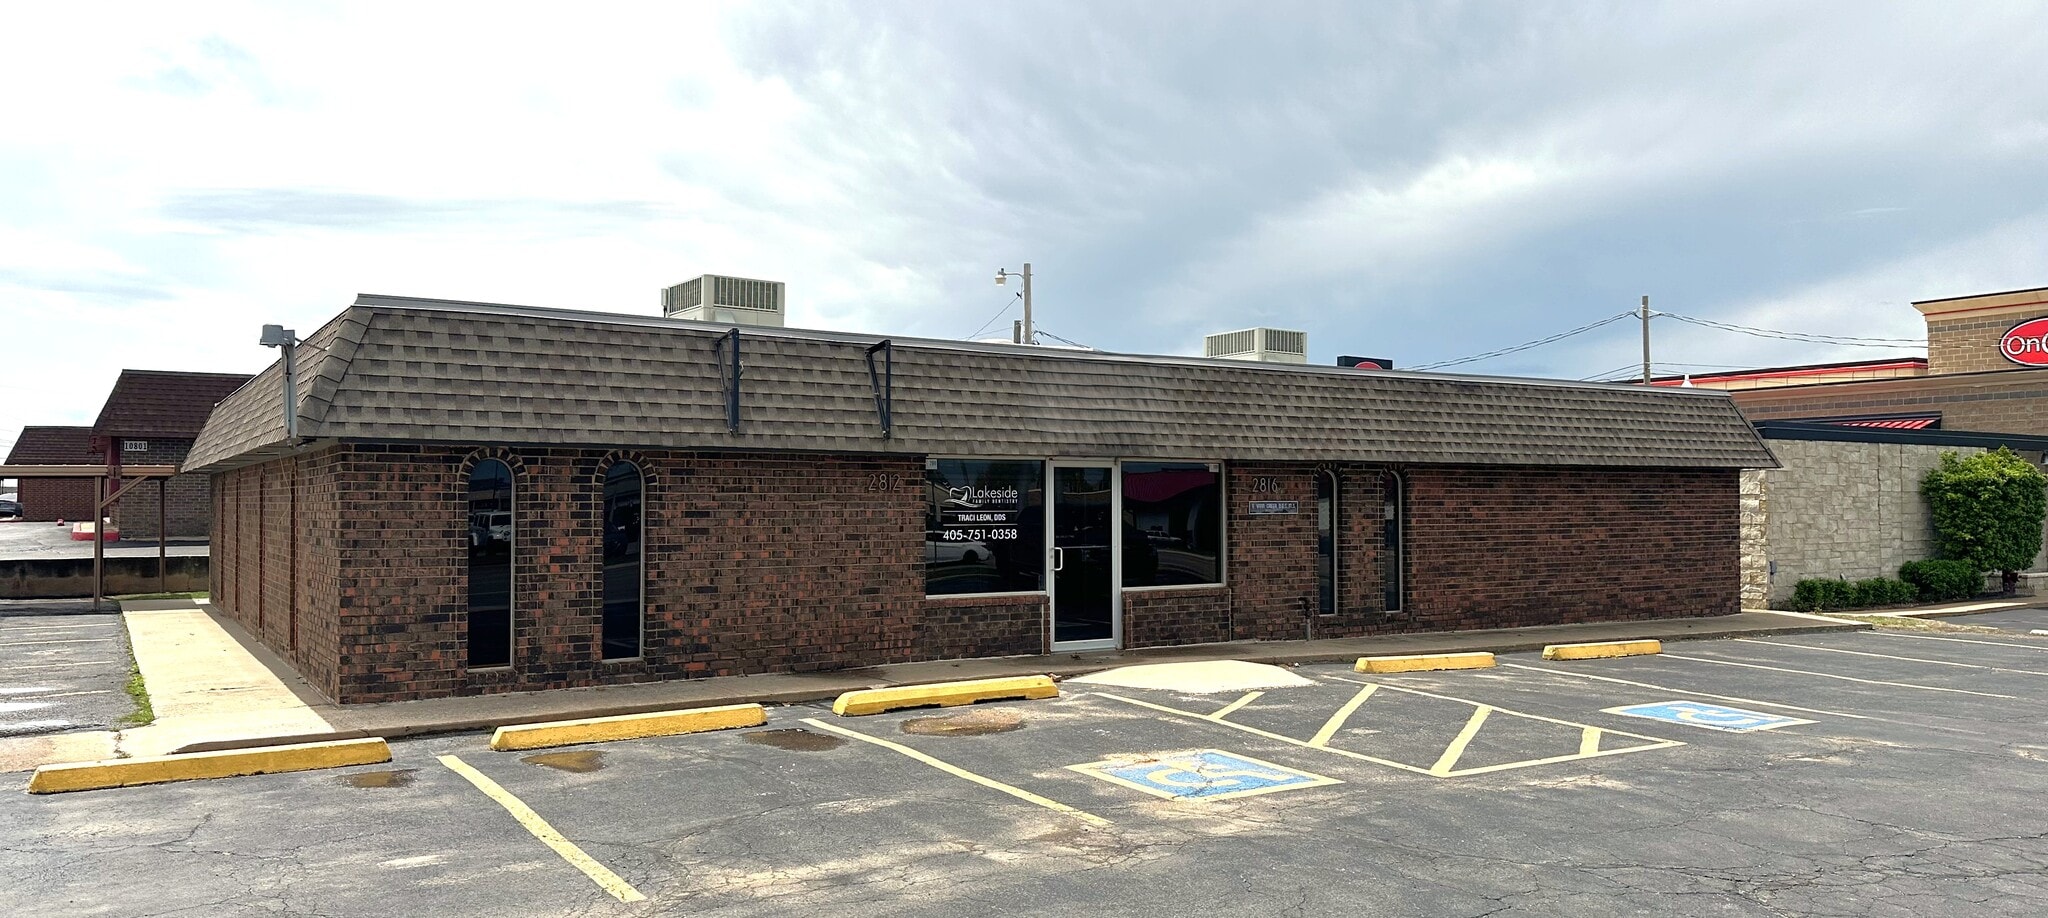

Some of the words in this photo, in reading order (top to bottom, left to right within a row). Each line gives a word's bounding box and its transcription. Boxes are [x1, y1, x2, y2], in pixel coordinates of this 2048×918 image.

[124, 442, 147, 450] 10801
[868, 473, 900, 491] 2812
[1252, 477, 1278, 493] 2816
[972, 485, 1018, 498] Lakeside
[943, 529, 1018, 541] 405-751-0358
